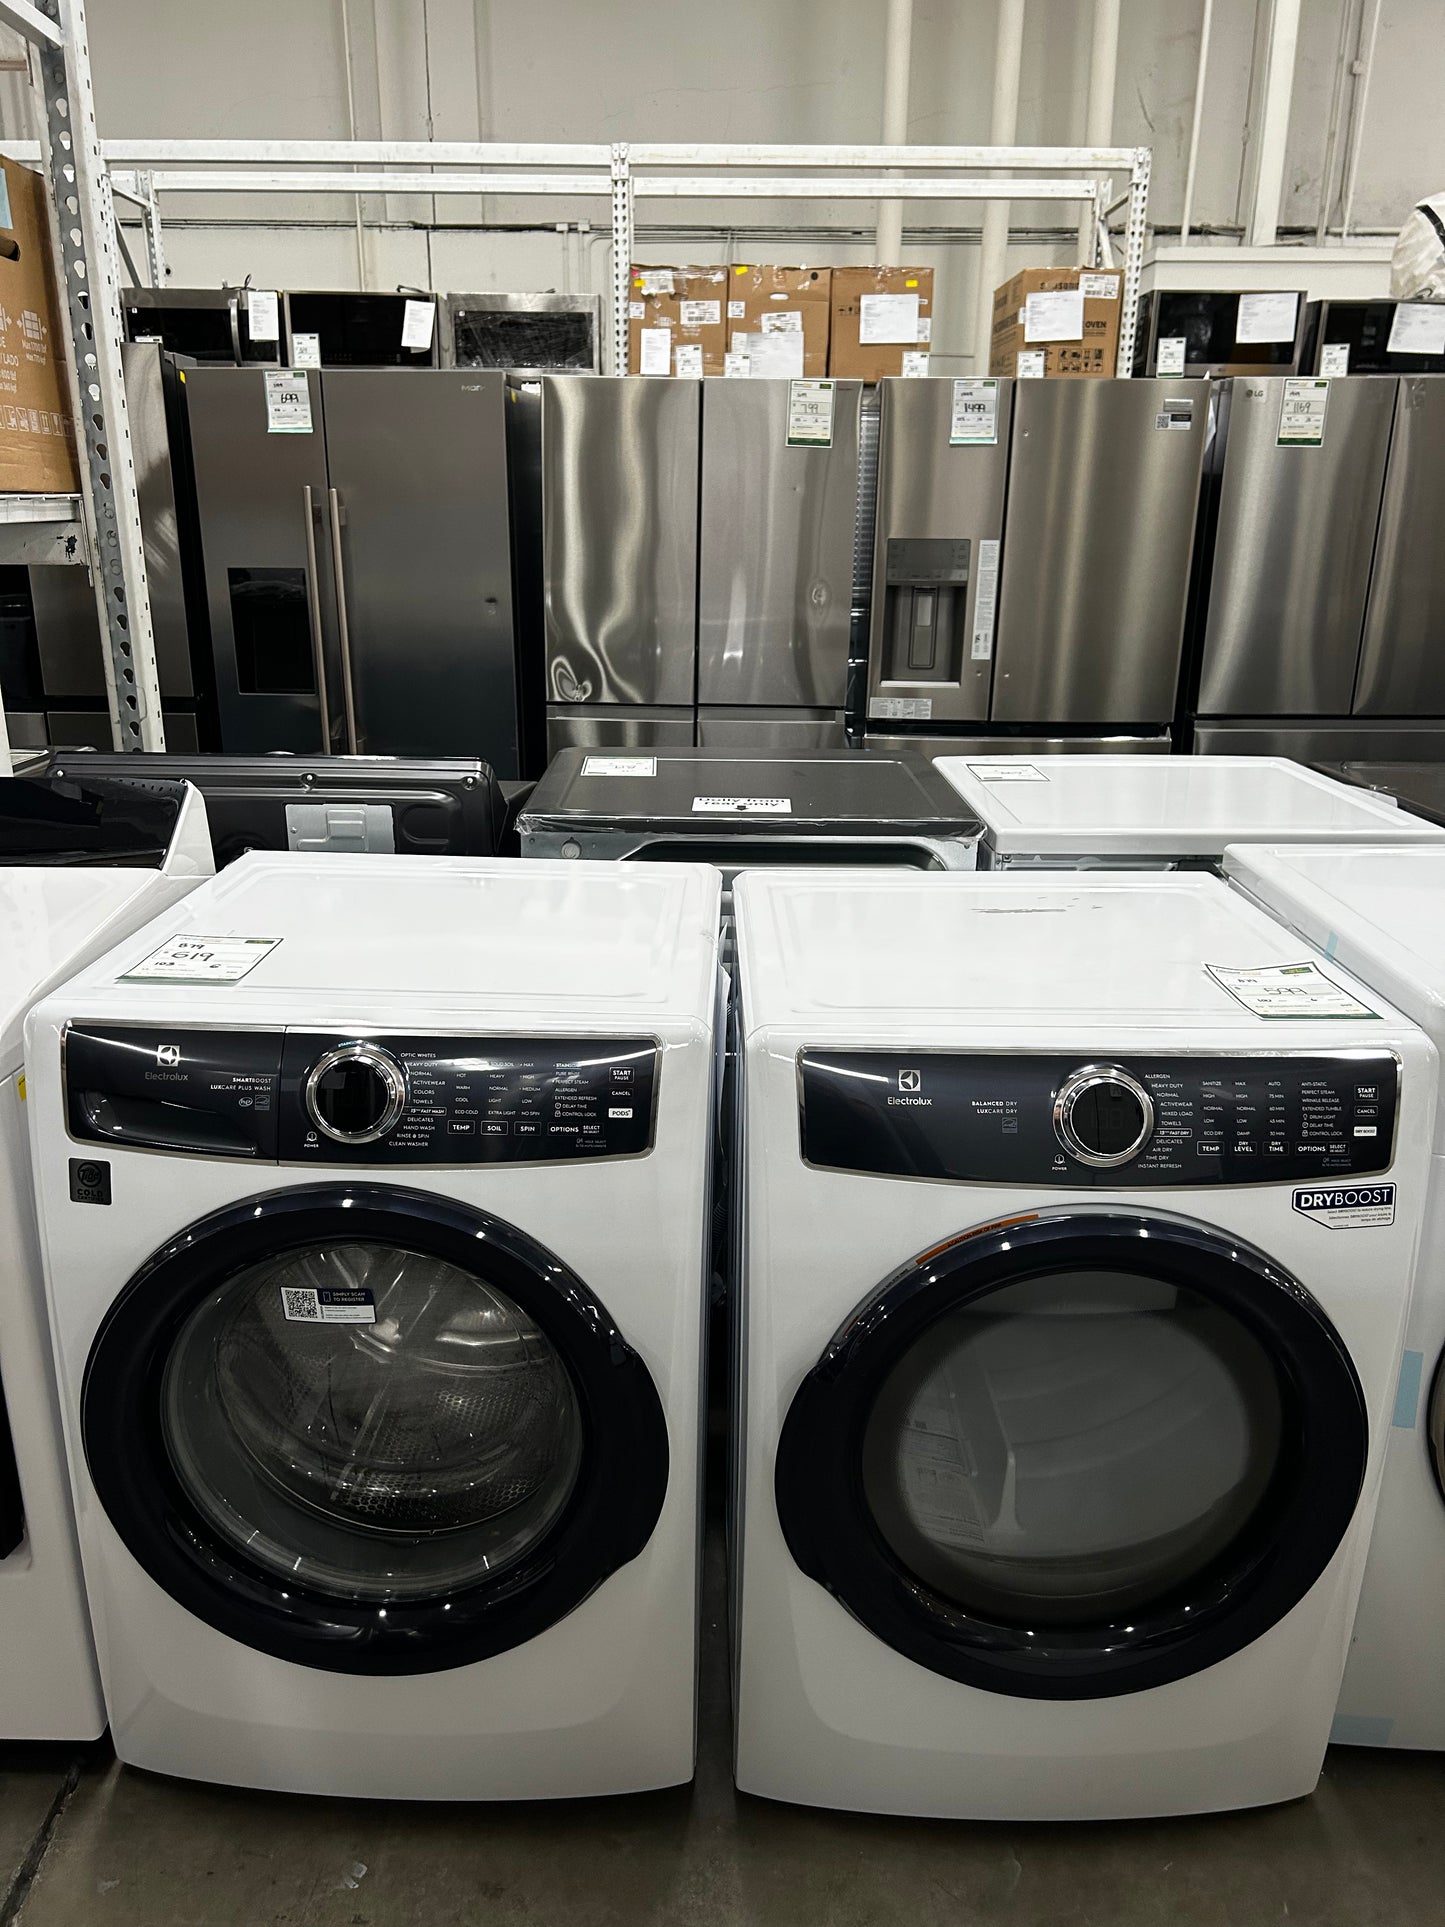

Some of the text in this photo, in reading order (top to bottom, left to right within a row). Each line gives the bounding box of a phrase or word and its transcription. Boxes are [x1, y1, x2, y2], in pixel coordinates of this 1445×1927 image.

[964, 403, 986, 412] 1499
[144, 1072, 188, 1080] Electrolux
[888, 1097, 932, 1106] Electrolux
[77, 1188, 104, 1197] COLD
[1300, 1189, 1390, 1207] DRYBOOST
